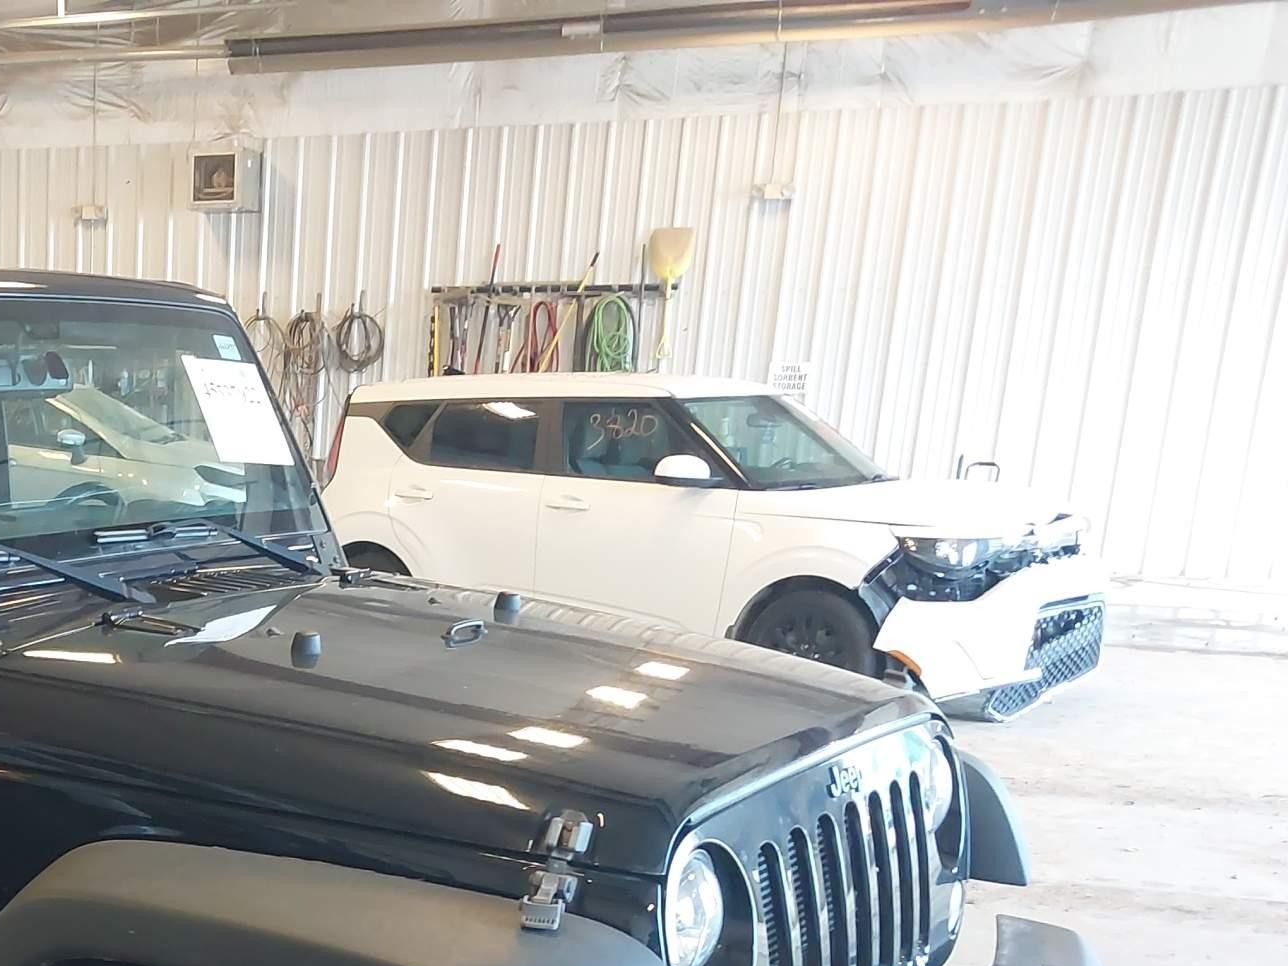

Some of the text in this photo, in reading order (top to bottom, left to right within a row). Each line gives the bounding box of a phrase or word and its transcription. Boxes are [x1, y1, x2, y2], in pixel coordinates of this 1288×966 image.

[782, 365, 801, 373] SPILL
[773, 373, 808, 382] SORBENT
[772, 382, 807, 391] STORAGE
